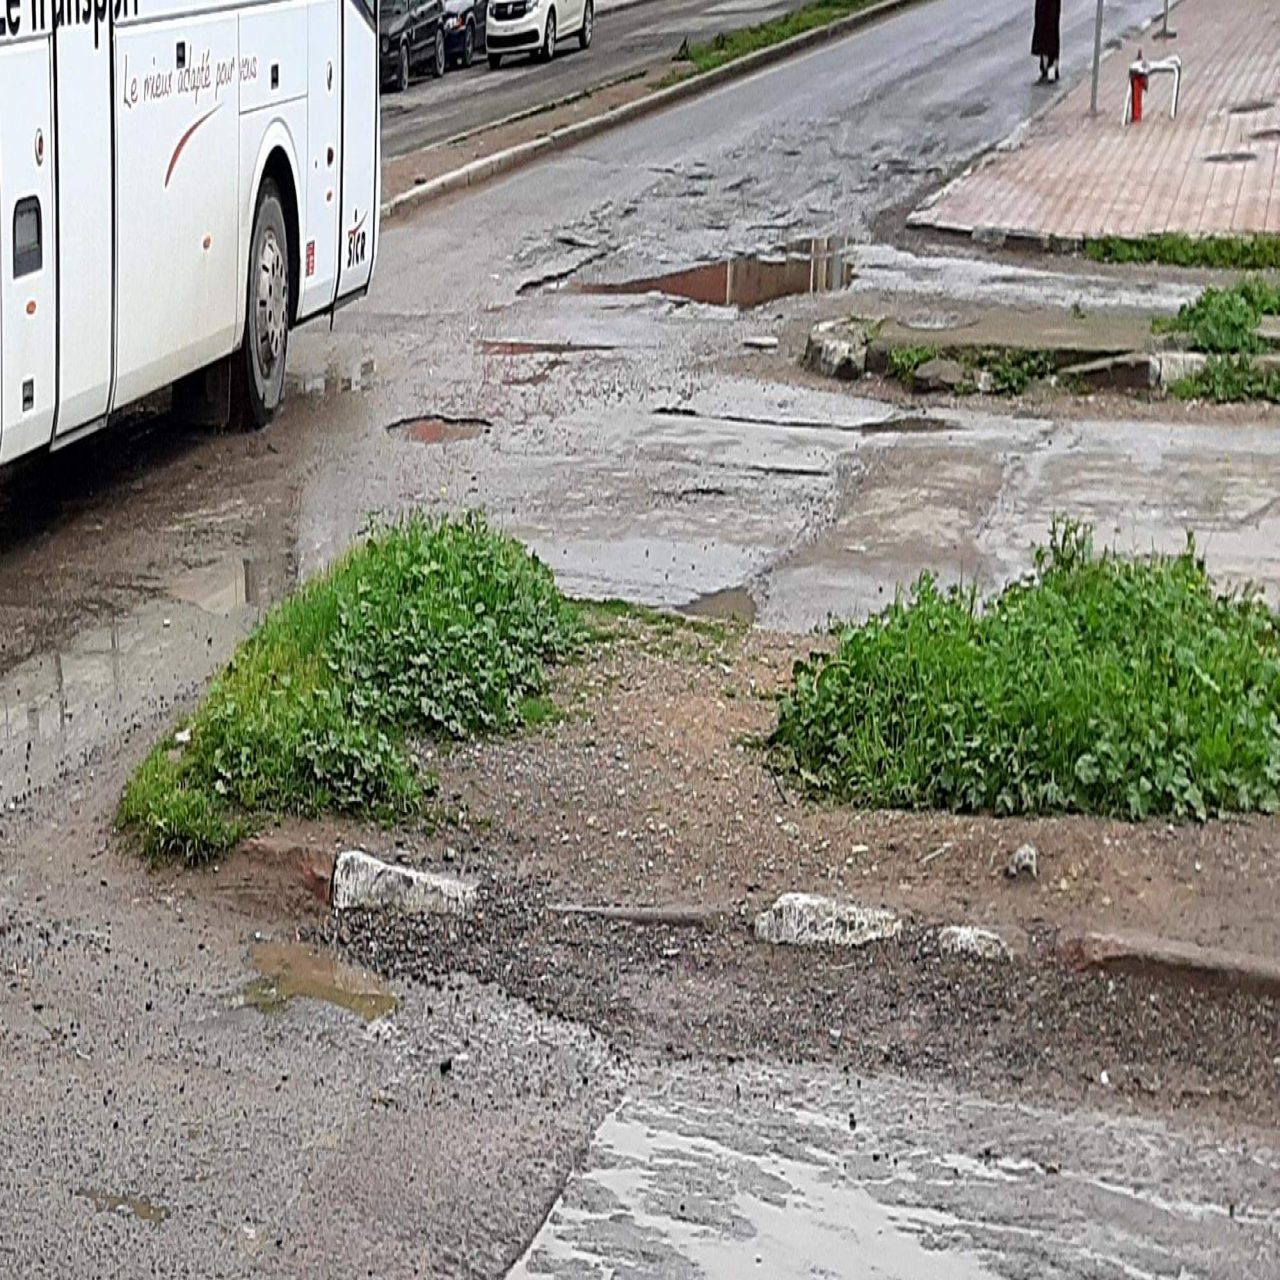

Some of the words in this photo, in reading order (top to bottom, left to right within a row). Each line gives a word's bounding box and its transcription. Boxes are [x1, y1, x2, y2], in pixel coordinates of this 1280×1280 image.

[123, 54, 138, 108] Le
[176, 43, 212, 104] adapté
[214, 56, 236, 101] pour
